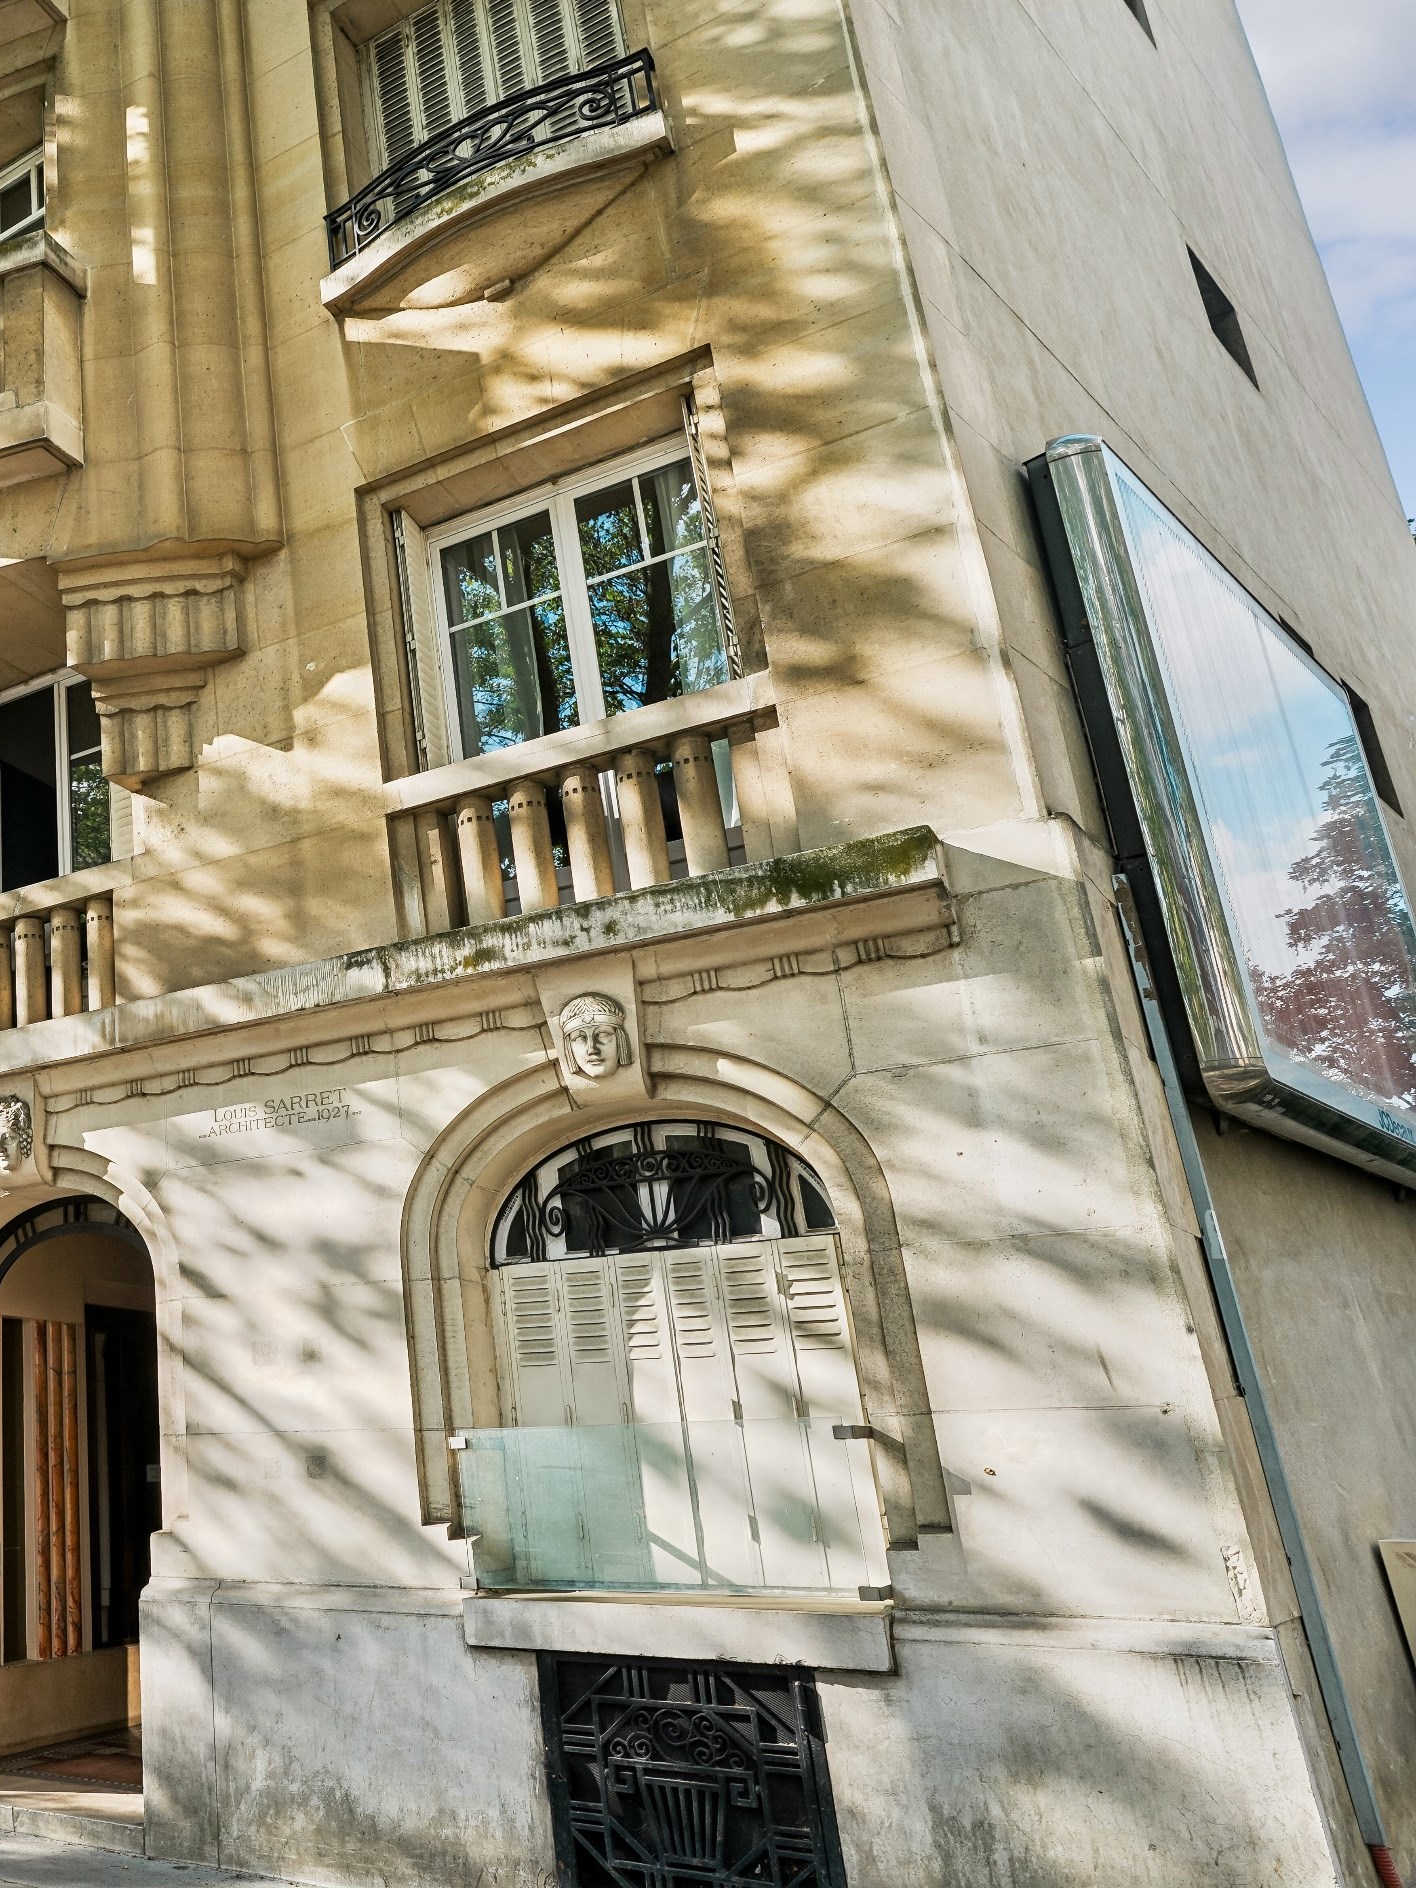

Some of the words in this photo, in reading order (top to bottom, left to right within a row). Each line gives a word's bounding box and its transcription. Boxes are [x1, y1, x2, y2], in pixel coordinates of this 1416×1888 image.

[208, 1111, 307, 1138] ARCHITECTE
[316, 1104, 350, 1123] 1927
[213, 1105, 258, 1123] LOUIS
[264, 1088, 347, 1115] SARRET
